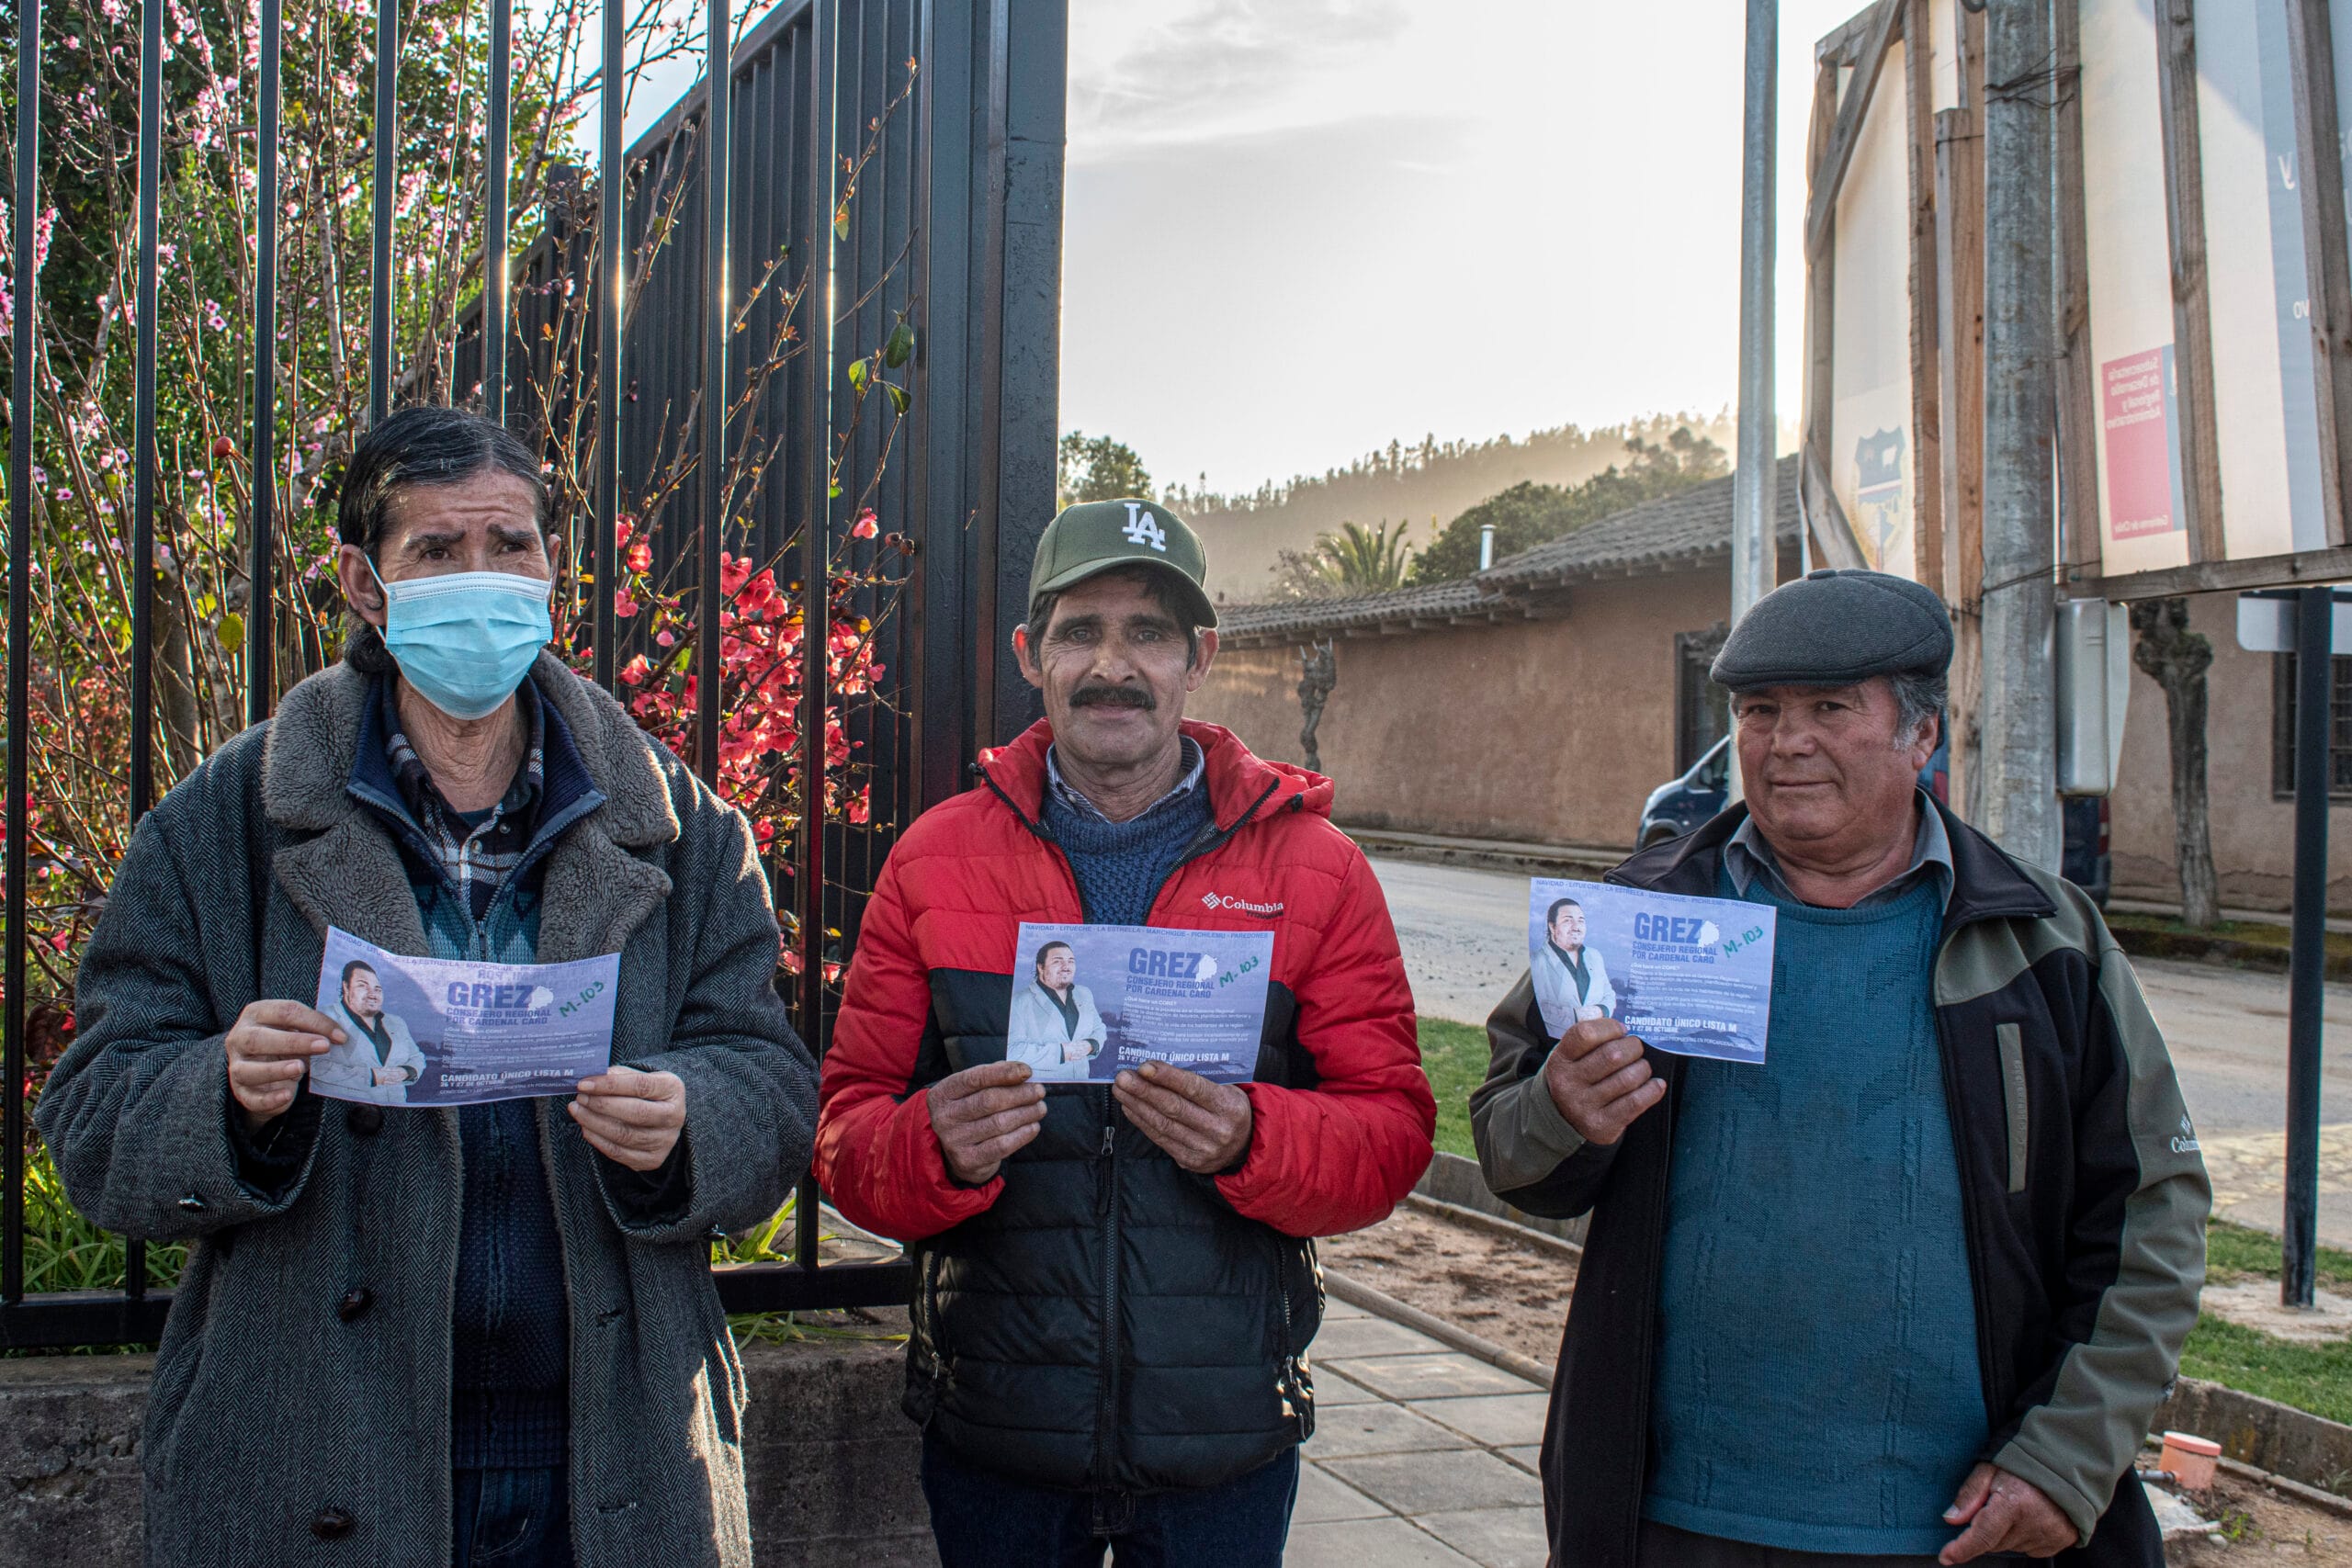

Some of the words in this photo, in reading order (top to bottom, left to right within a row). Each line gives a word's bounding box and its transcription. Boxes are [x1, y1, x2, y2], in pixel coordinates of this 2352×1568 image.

[1123, 503, 1167, 552] LA
[1221, 896, 1284, 913] Columbia
[1634, 911, 1703, 944] GREZ
[1633, 941, 1677, 953] CONSEJERO
[1679, 945, 1718, 956] REGIONAL
[1723, 925, 1763, 958] M-103
[1129, 947, 1202, 979] GREZ
[1632, 950, 1646, 959] POR
[1648, 953, 1690, 963] CARDENAL
[1692, 955, 1714, 964] CARO
[1219, 955, 1260, 988] M-103
[1125, 984, 1143, 993] POR
[1145, 987, 1188, 998] CARDENAL
[1189, 990, 1212, 998] CARO
[1126, 975, 1174, 988] CONSEJERO
[1176, 980, 1215, 990] REGIONAL
[447, 981, 534, 1009] GREZ
[559, 980, 605, 1019] M-103
[446, 1016, 466, 1024] POR
[468, 1017, 519, 1026] CARDENAL
[522, 1017, 548, 1026] CARO
[447, 1007, 503, 1018] CONSEJERO
[505, 1009, 552, 1018] REGIONAL
[1624, 1015, 1672, 1027] CANDIDATO
[1674, 1016, 1701, 1028] ÚNICO
[1702, 1020, 1726, 1032] LISTA
[1728, 1023, 1737, 1032] M
[1118, 1045, 1168, 1061] CANDIDATO
[1169, 1051, 1195, 1062] ÚNICO
[1196, 1053, 1219, 1062] LISTA
[1220, 1053, 1229, 1061] M
[441, 1073, 498, 1083] CANDIDATO
[501, 1070, 531, 1080] ÚNICO
[533, 1068, 561, 1077] LISTA
[563, 1068, 574, 1077] M
